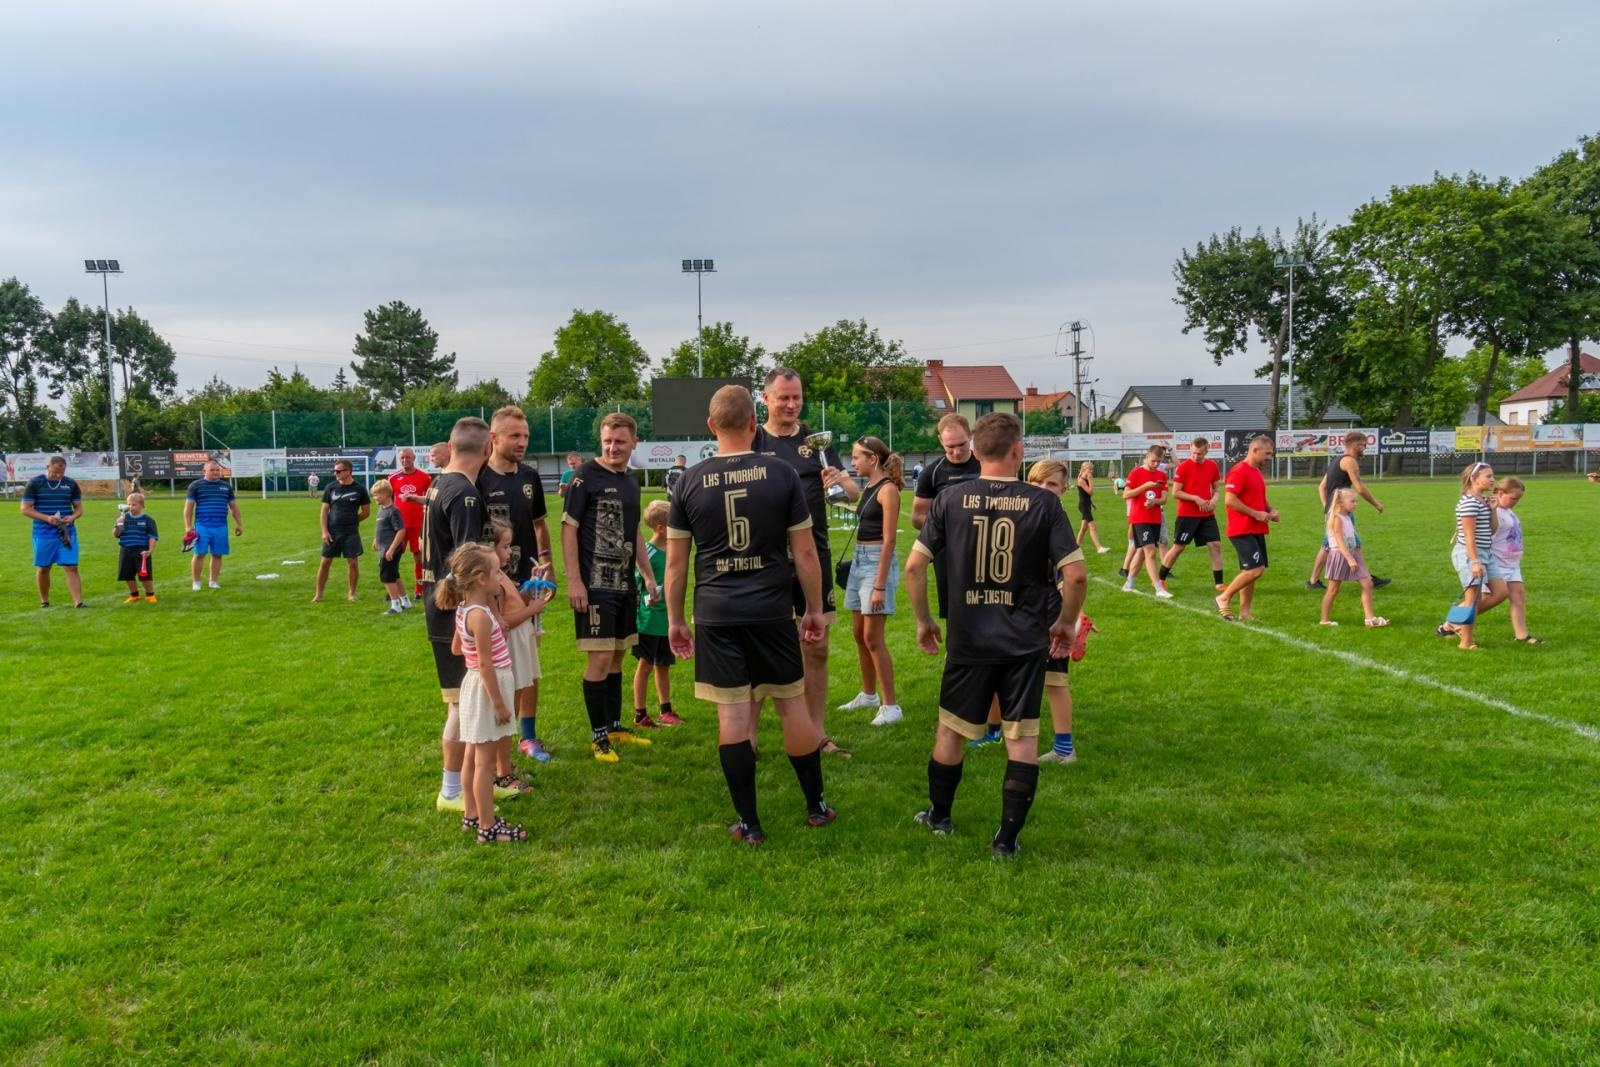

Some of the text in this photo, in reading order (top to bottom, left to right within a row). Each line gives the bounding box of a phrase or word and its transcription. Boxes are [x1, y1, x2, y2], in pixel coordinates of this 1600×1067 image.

[724, 465, 767, 485] TWORKÓW
[984, 495, 1030, 512] TWORKÓW
[1142, 531, 1149, 542] 8
[1180, 532, 1189, 542] 11
[972, 516, 1015, 584] 18
[1252, 551, 1260, 564] 9
